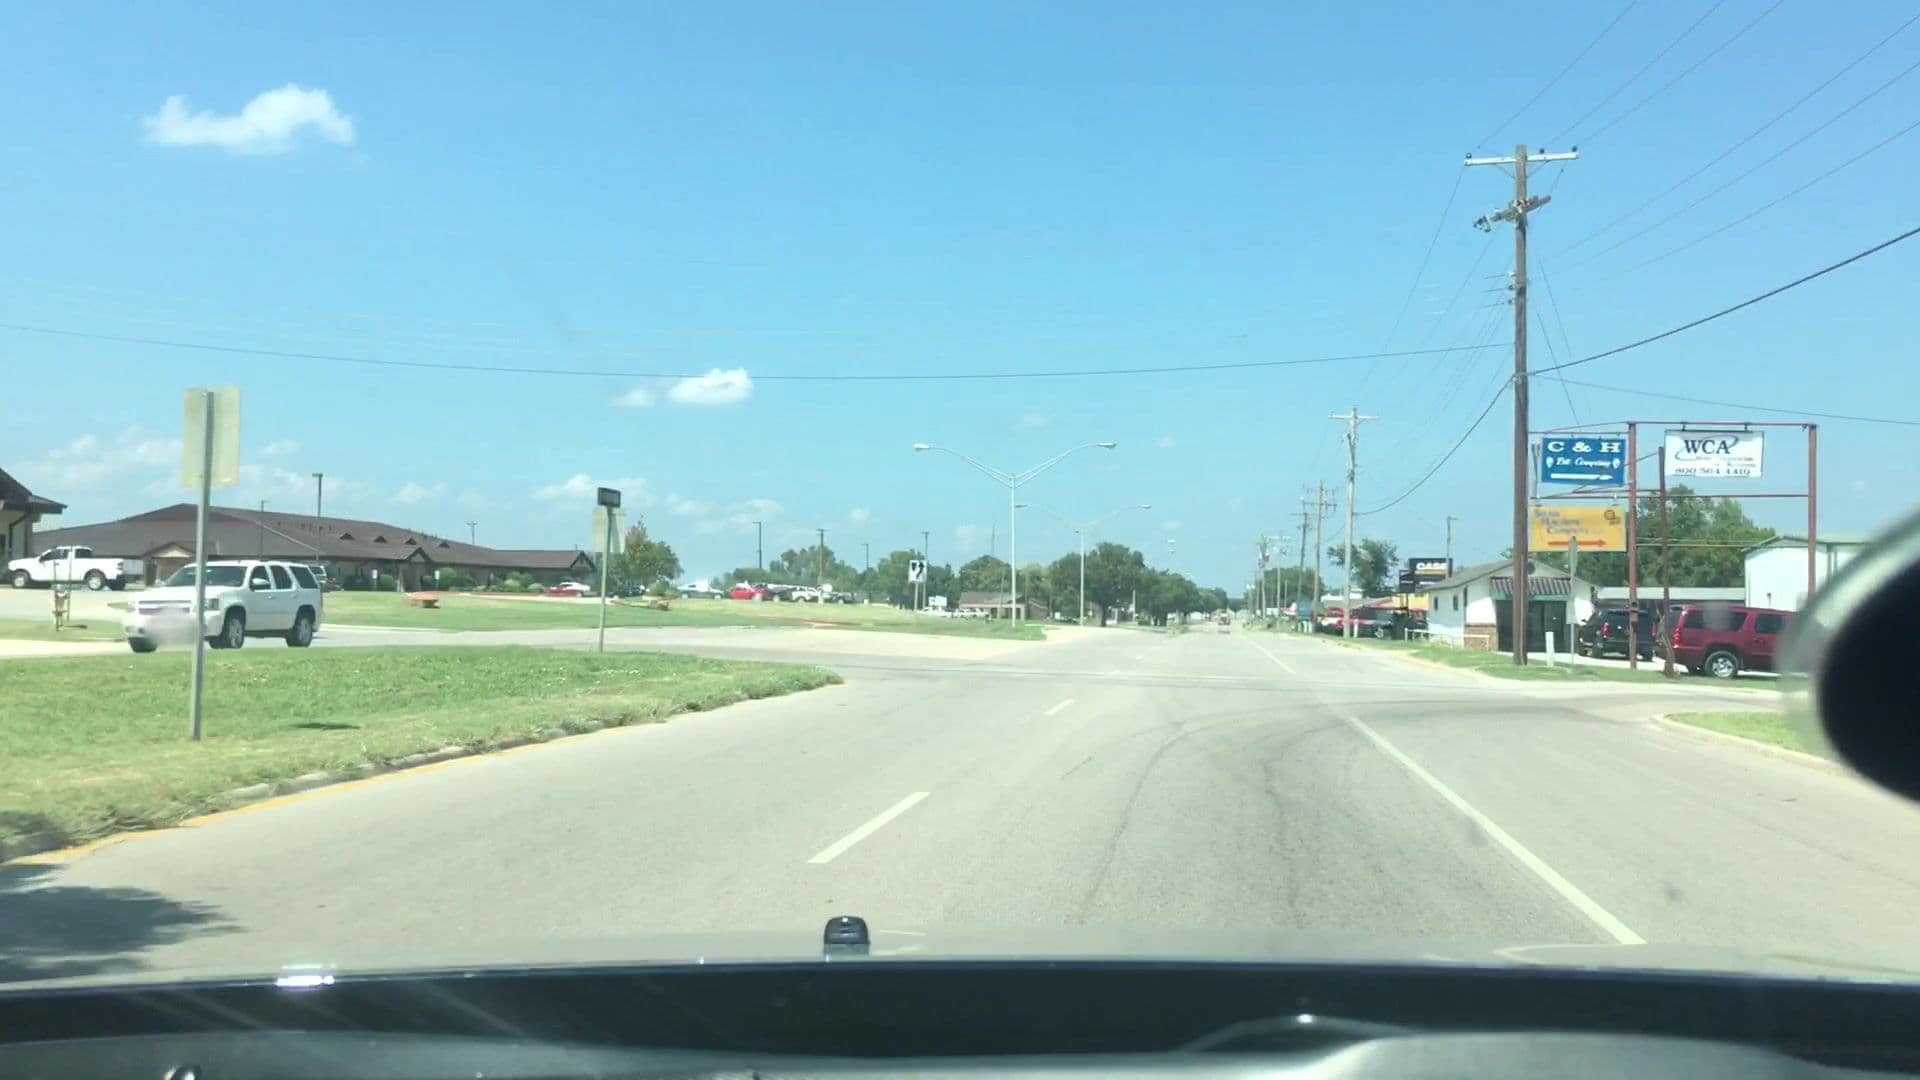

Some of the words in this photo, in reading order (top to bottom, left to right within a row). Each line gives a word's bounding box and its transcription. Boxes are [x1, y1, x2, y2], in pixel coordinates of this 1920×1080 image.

[1547, 441, 1565, 453] C
[1571, 441, 1592, 453] &
[1600, 442, 1621, 454] H
[1684, 439, 1730, 455] WCA
